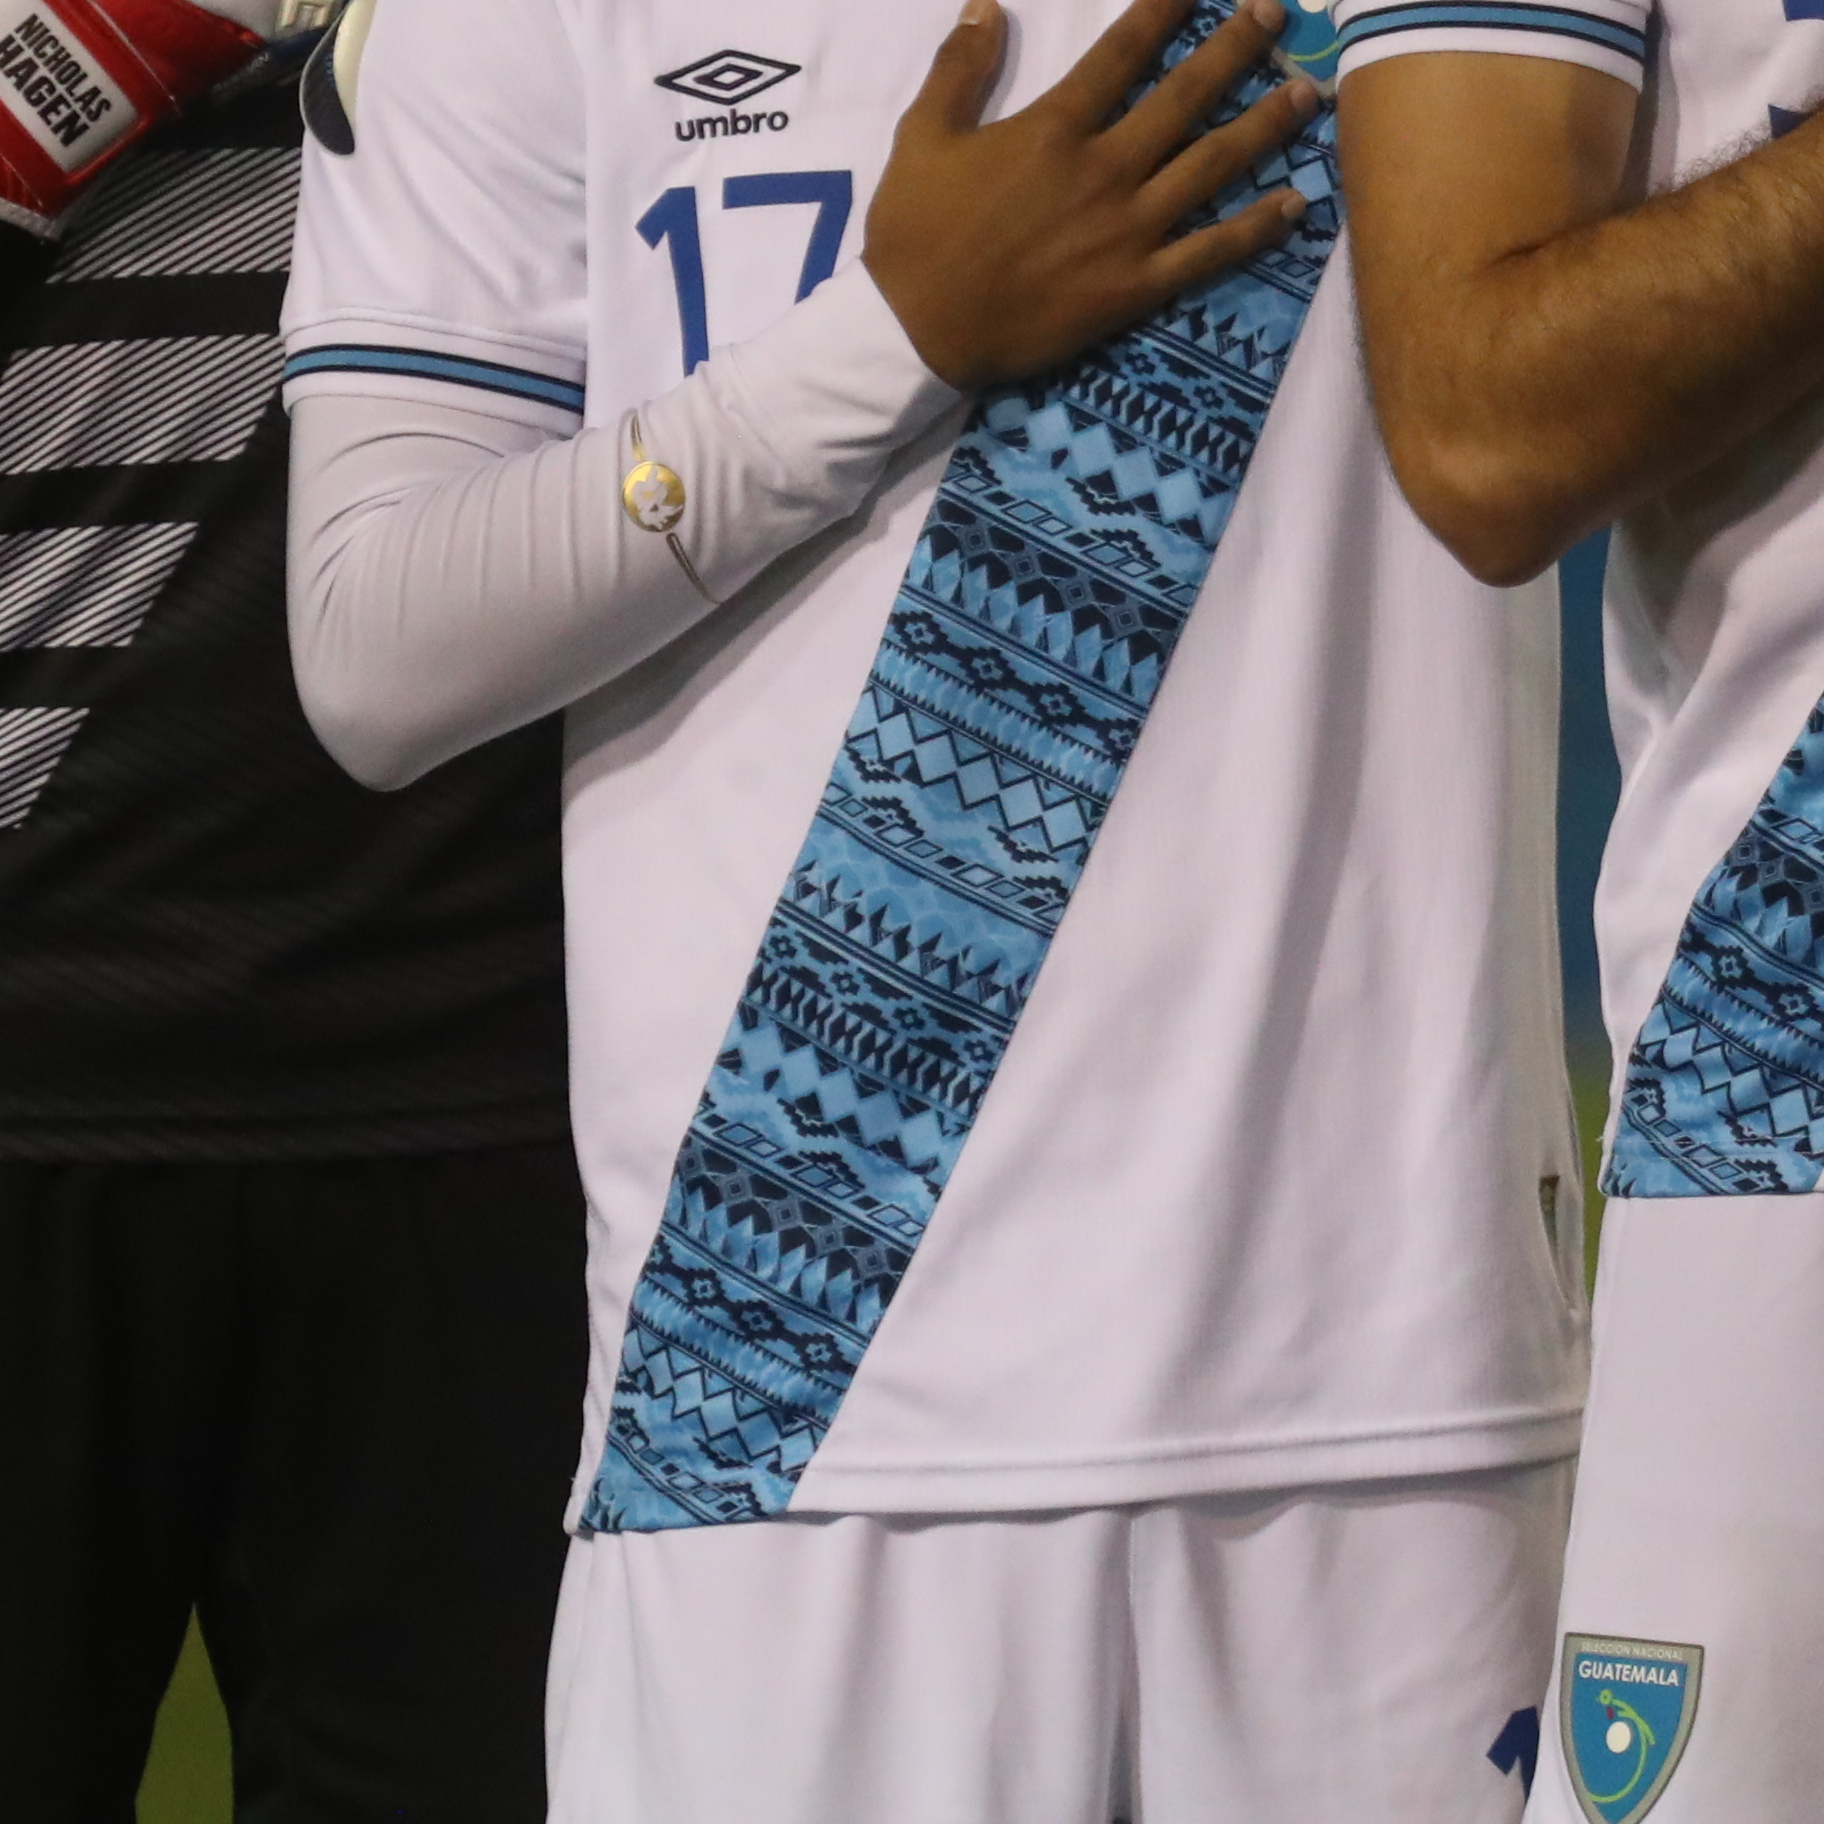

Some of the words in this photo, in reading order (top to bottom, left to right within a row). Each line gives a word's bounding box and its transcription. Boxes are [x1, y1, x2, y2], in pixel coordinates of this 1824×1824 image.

[13, 14, 112, 123] NICHOLAS
[675, 109, 789, 142] umbro
[635, 169, 853, 379] 17
[1578, 1660, 1680, 1687] GUATEMALA
